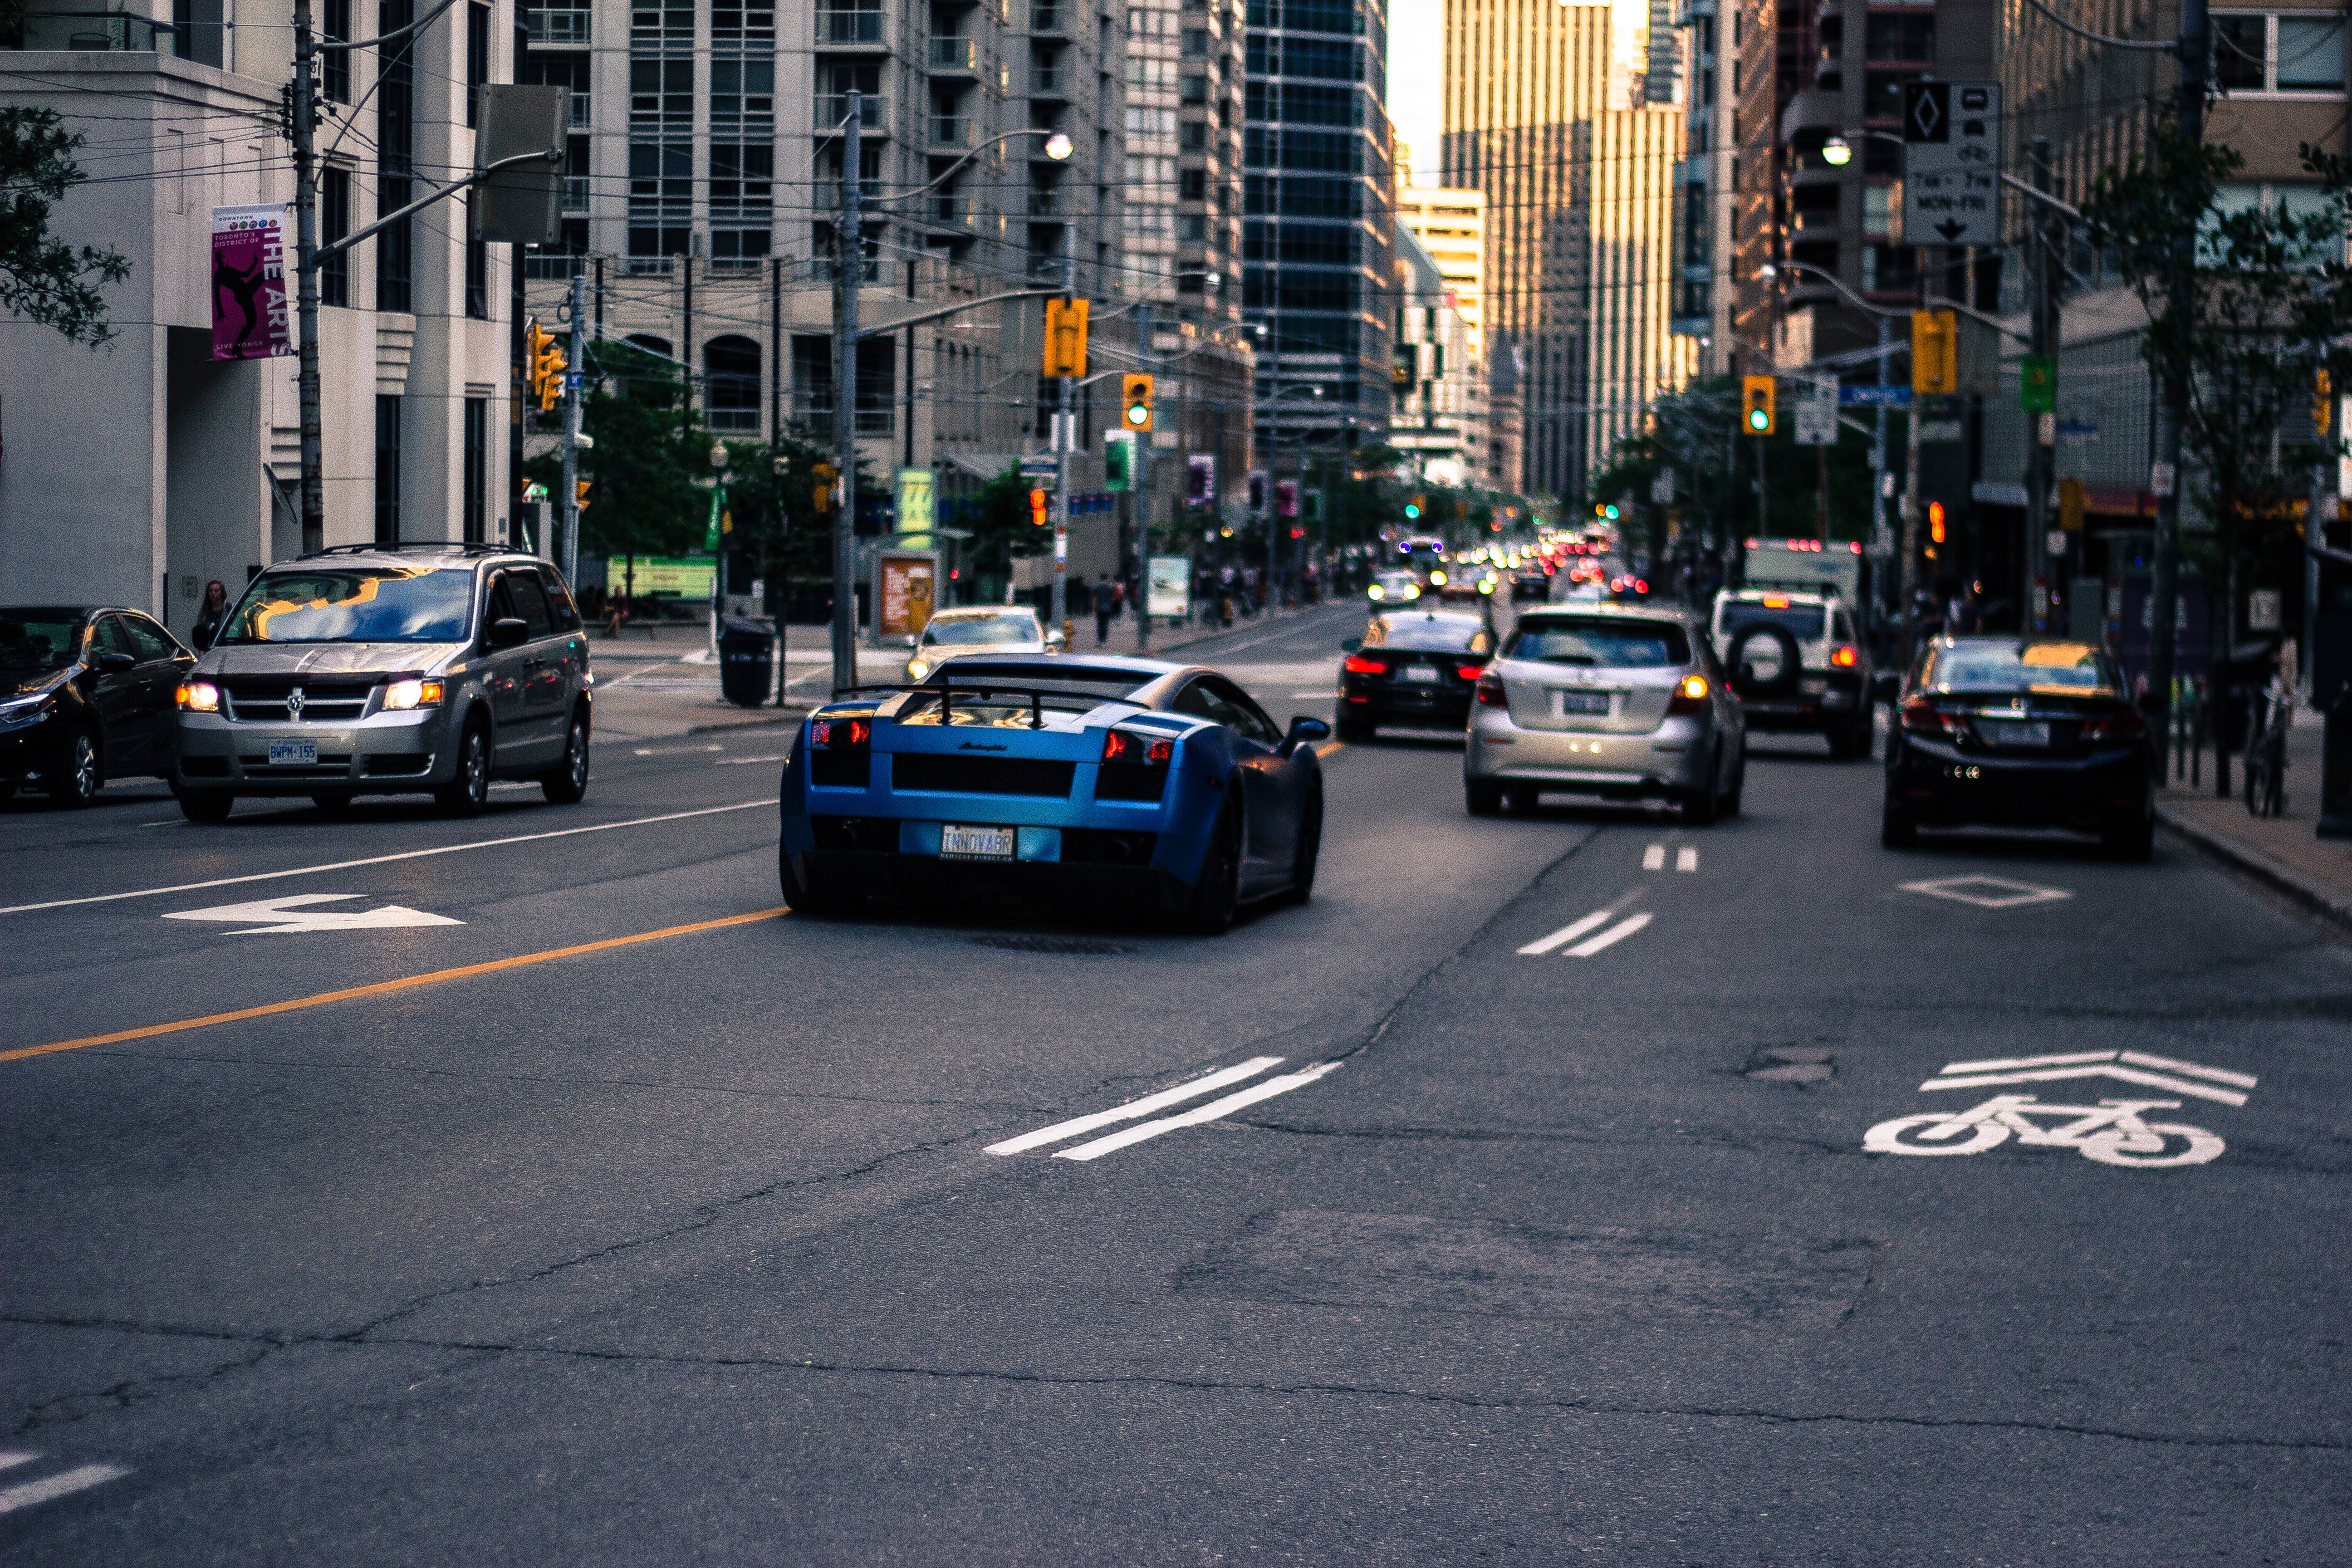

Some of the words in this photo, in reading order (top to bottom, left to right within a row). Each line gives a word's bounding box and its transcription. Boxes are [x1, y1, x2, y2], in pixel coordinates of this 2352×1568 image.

[215, 232, 255, 241] TORONTO'S
[215, 239, 247, 247] DISTRICT
[264, 229, 285, 280] THE
[265, 287, 292, 356] ARTS
[299, 745, 315, 758] 155
